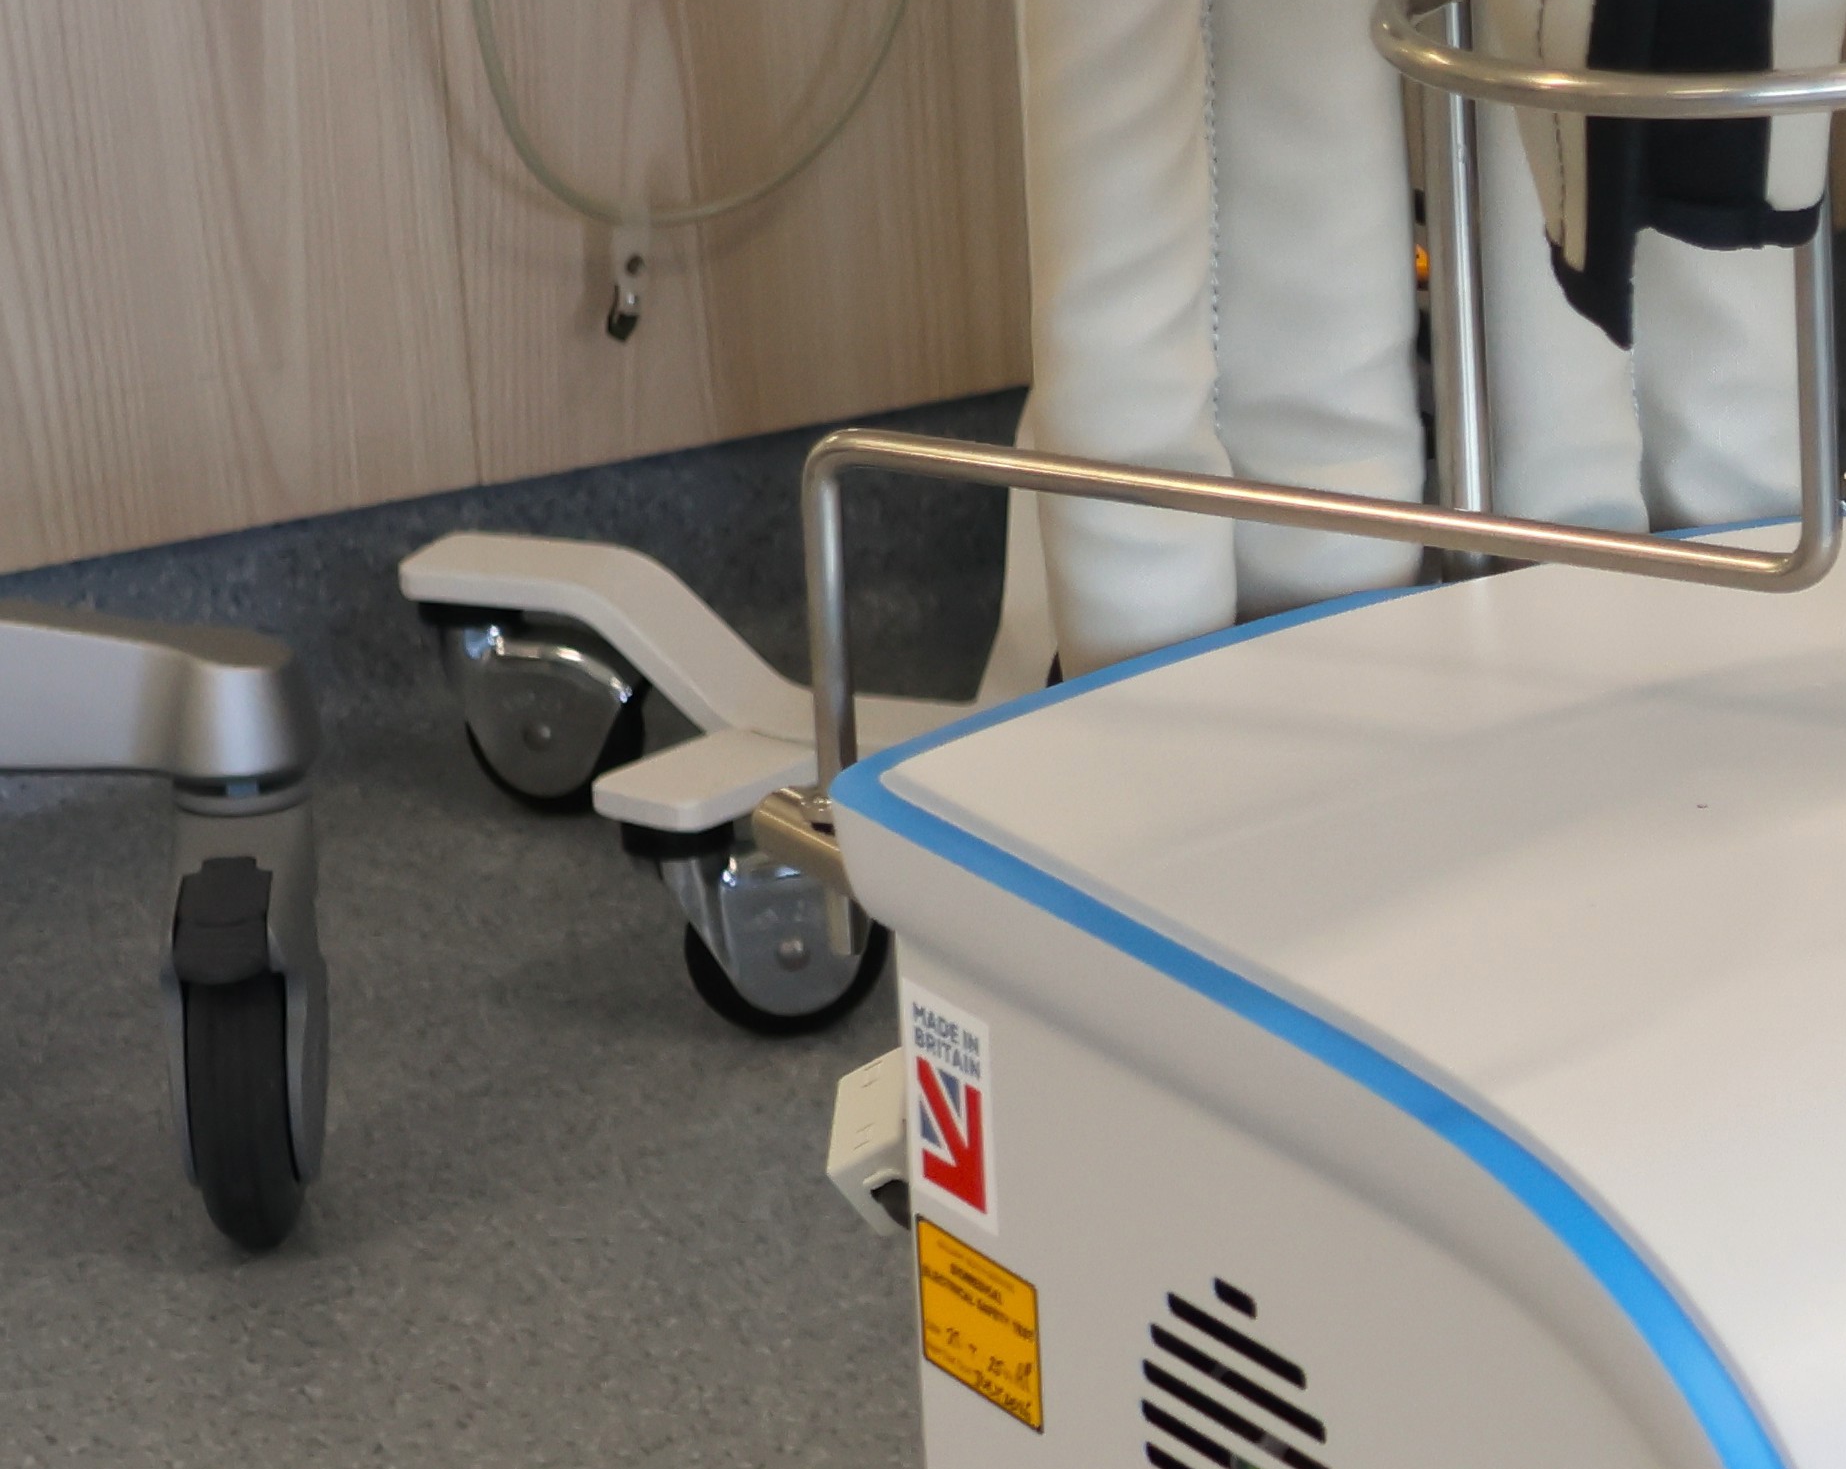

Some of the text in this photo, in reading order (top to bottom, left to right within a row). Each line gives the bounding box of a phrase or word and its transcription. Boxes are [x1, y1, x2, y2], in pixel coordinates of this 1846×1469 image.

[912, 1001, 980, 1057] MADE IN
[914, 1026, 982, 1081] BRITAIN
